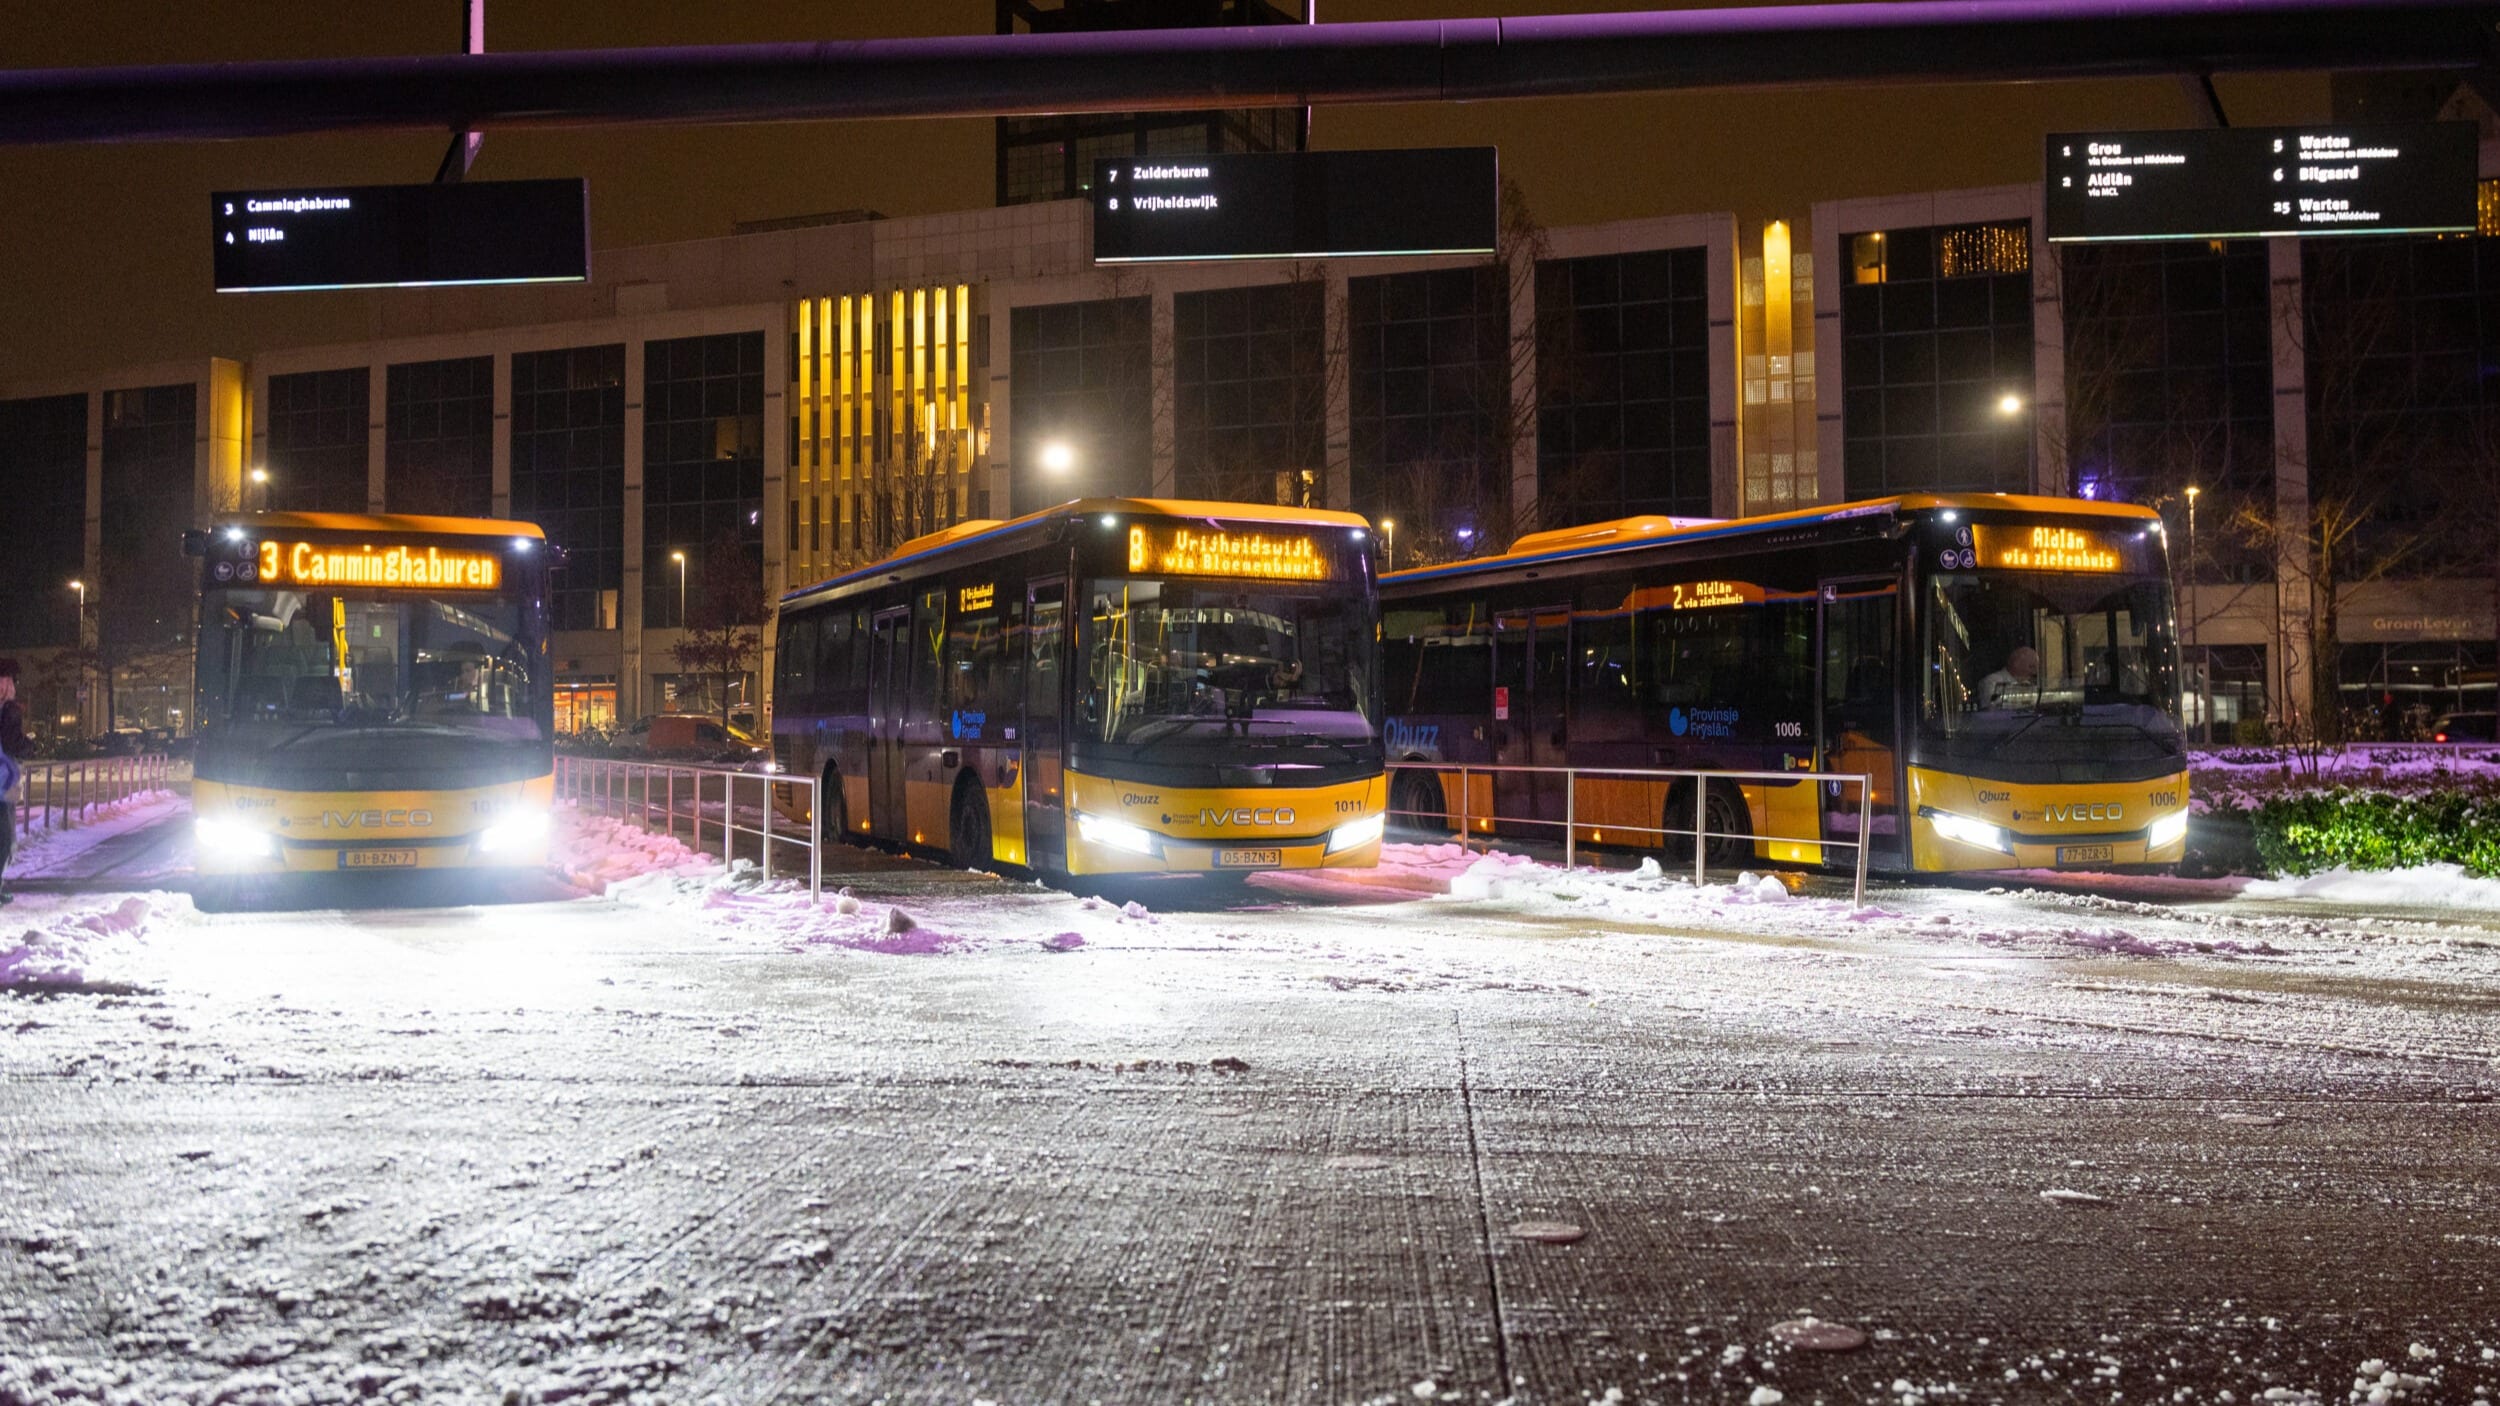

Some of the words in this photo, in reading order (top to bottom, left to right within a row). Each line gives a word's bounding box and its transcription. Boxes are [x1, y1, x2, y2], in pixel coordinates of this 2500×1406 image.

[2063, 146, 2071, 156] 1
[2088, 143, 2122, 155] Grou
[2273, 139, 2283, 153] 5
[2299, 136, 2350, 149] Warten
[2088, 157, 2101, 166] via
[2299, 150, 2313, 160] via
[1109, 169, 1118, 182] 7
[1133, 166, 1209, 179] Zuiderburen
[2062, 176, 2071, 187] 2
[2088, 172, 2132, 186] Aldlân
[2273, 168, 2284, 182] 6
[2299, 165, 2359, 182] Bilgaard
[2088, 188, 2101, 197] via
[2101, 187, 2119, 196] MCL
[225, 203, 233, 215] 3
[247, 197, 350, 212] Camminghaburen
[1109, 198, 1118, 210] 8
[1133, 195, 1218, 211] Vrijheidswijk
[2273, 201, 2290, 215] 25
[2299, 198, 2349, 211] Warten
[2299, 213, 2313, 222] via
[226, 232, 234, 244] 4
[1176, 531, 1313, 559] Vrijheidswijk
[2033, 527, 2085, 550] Aldlân
[1130, 527, 1144, 567] 8
[260, 541, 278, 579] 3
[293, 542, 493, 586] Camminghaburen
[1166, 554, 1195, 569] via
[1203, 553, 1322, 576] Bloemenbuurt
[2004, 552, 2029, 566] via
[2035, 551, 2114, 569] ziekenhuis
[1696, 580, 1732, 596] Aldlân
[1673, 584, 1682, 610] 2
[1684, 597, 1698, 608] via
[1700, 593, 1744, 607] ziekenhuis
[1690, 707, 1739, 723] Provinsje
[1690, 720, 1729, 740] Fryslân
[1775, 722, 1802, 738] 1006
[1122, 793, 1160, 806] Qbuzz
[1979, 790, 2011, 804] Qbuzz
[2148, 791, 2177, 807] 1006
[1334, 799, 1362, 813] 1011
[2044, 802, 2123, 823] IVECO
[322, 809, 434, 829] IVECO
[1200, 807, 1296, 826] IVECO
[353, 852, 410, 866] 81-BZN-7
[1223, 851, 1278, 865] 05-BZN-3
